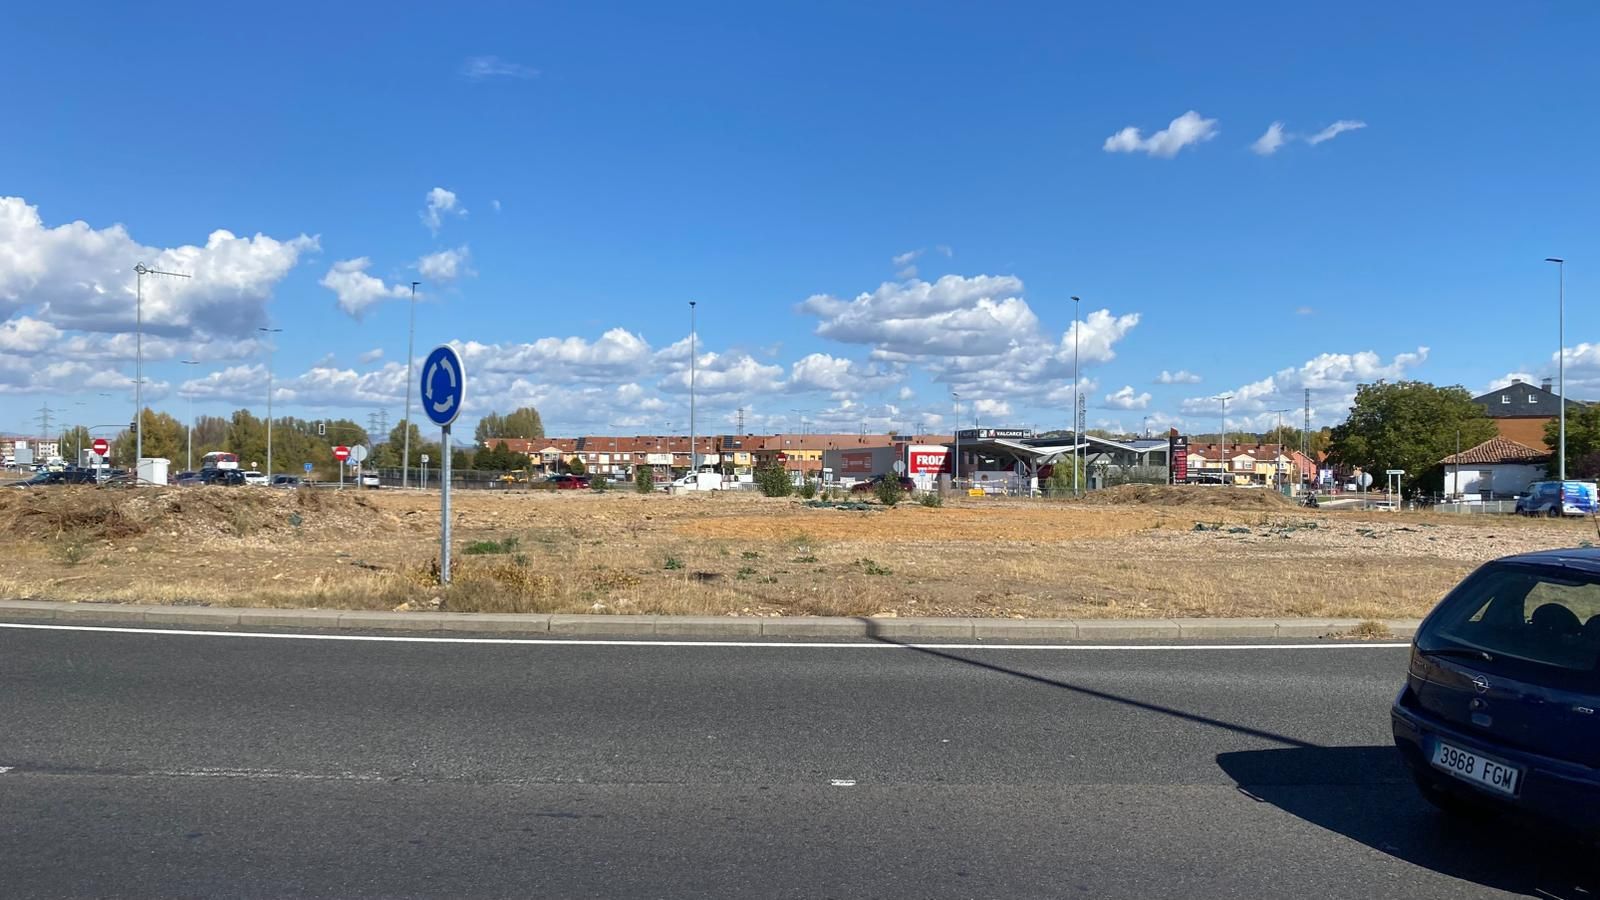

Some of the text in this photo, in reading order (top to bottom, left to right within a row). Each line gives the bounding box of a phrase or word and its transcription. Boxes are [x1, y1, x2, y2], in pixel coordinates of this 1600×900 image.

[916, 455, 946, 466] FROIZ
[1440, 747, 1513, 790] 3968 FGM
